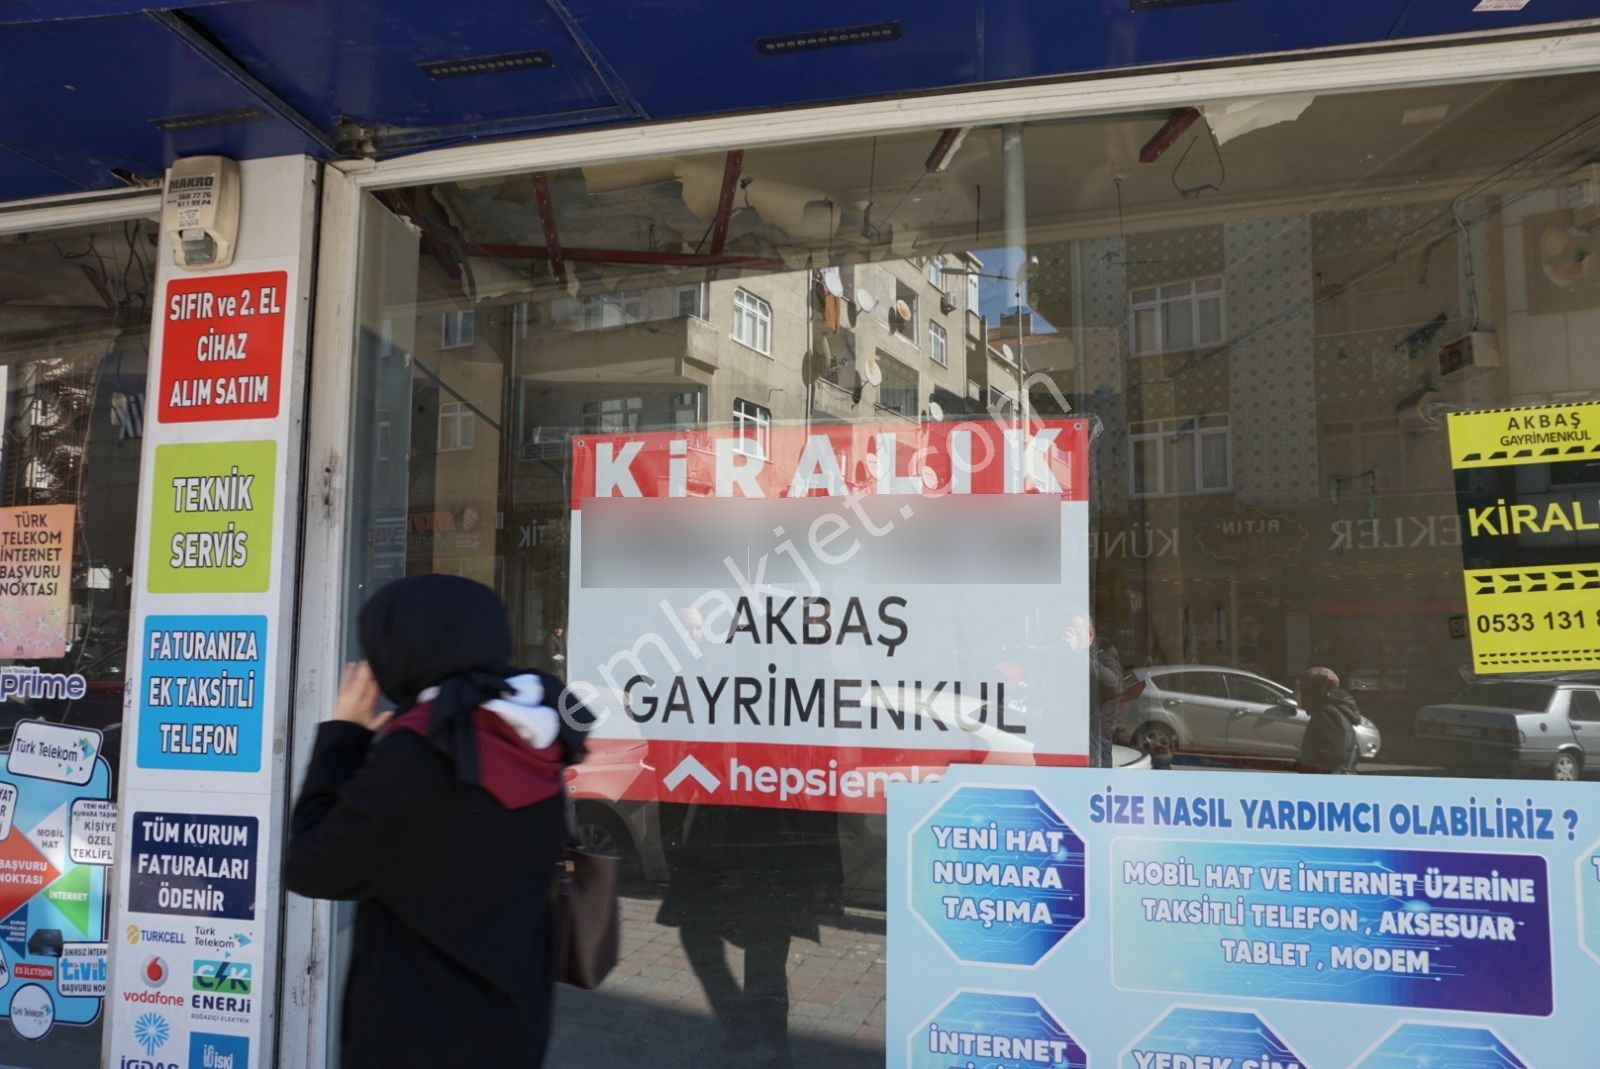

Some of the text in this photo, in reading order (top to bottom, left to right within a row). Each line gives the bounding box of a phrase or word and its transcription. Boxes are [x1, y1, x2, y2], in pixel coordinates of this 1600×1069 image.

[168, 176, 214, 190] MAKRO
[169, 287, 280, 321] SIFIR ve 2. EL
[197, 327, 248, 362] CİHAZ
[169, 375, 269, 408] ALIM SATIM
[1507, 412, 1581, 431] AKBAŞ
[1500, 429, 1592, 447] GAYRİMENKUL
[172, 466, 255, 512] TEKNİK
[14, 511, 48, 528] TÜRK
[1468, 498, 1600, 537] KİRAL
[2, 531, 62, 545] TELEKOM
[170, 523, 248, 568] SERVİS
[0, 545, 62, 562] İNTERNET
[0, 565, 60, 583] BAŞVURU
[0, 582, 58, 596] NOKTASI
[725, 596, 908, 657] AKBAŞ
[1477, 612, 1535, 634] 0533
[1543, 610, 1586, 630] 131
[149, 630, 258, 661] FATURANIZA
[0, 669, 85, 701] prime
[149, 670, 255, 709] EK TAKSİTLİ
[623, 663, 1026, 734] GAYRİMENKUL
[16, 738, 78, 762] Türk Telekom
[160, 723, 238, 755] TELEFON
[84, 820, 117, 833] KİŞİYE
[1090, 785, 1578, 841] SİZE NASIL YARDIMCI OLABİLİRİZ ?
[37, 828, 65, 838] MOBİL
[87, 833, 112, 846] ÖZEL
[142, 817, 248, 846] TÜM KURUM
[931, 821, 1063, 854] YENİ HAT
[138, 854, 249, 880] FATURALARI
[933, 860, 1063, 889] NUMARA
[1124, 856, 1535, 903] MOBİL HAT VE İNTERNET ÜZERİNE
[158, 883, 224, 912] ÖDENİR
[943, 895, 1052, 928] TAŞIMA
[195, 926, 215, 936] Türk
[1141, 894, 1245, 925] TAKSİTLİ
[1251, 904, 1357, 932] TELEFON
[1379, 911, 1516, 941] AKSESUAR
[141, 930, 186, 944] TURKCELL
[195, 937, 234, 948] Telekom
[1221, 938, 1310, 967] TABLET
[1330, 946, 1429, 974] MODEM
[123, 991, 184, 1006] vodafone
[929, 1023, 1067, 1064] İNTERNET
